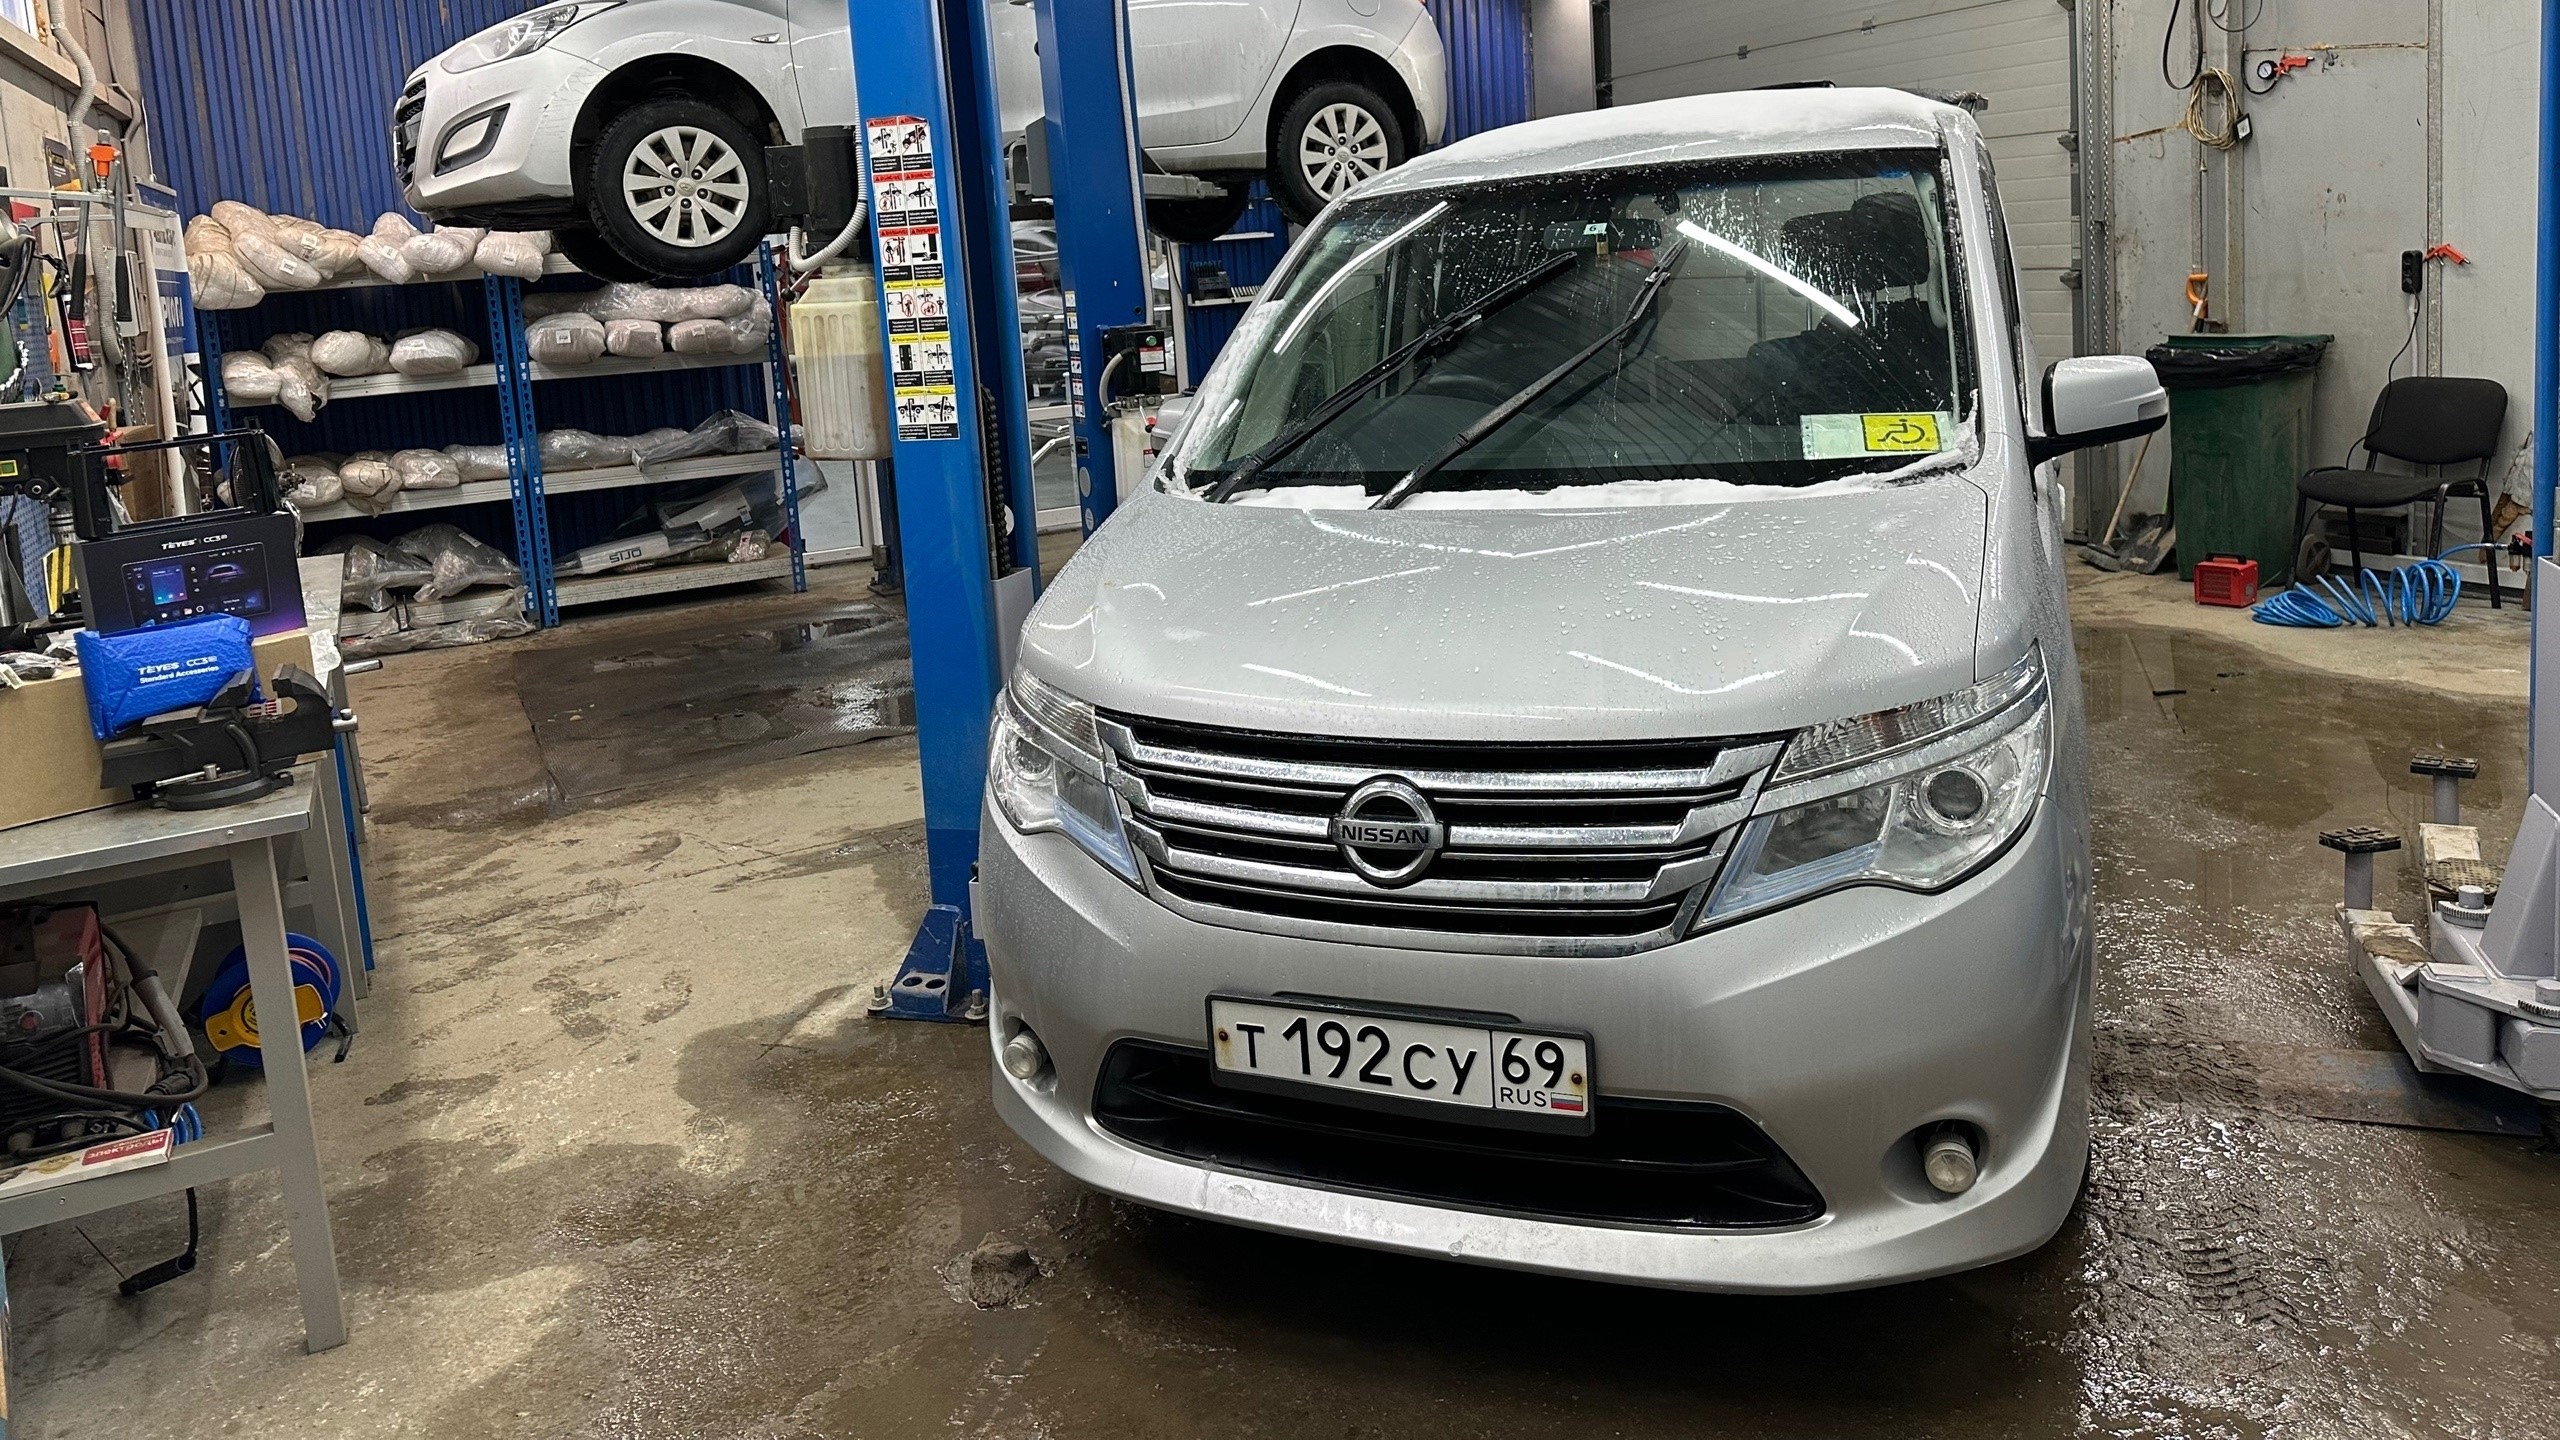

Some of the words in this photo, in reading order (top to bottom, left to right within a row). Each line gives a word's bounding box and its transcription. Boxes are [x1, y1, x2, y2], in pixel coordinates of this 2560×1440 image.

[161, 539, 195, 550] TEYES
[138, 662, 179, 675] TEYES
[140, 672, 175, 683] Standard
[176, 666, 219, 677] Accessories
[1341, 825, 1430, 845] NISSAN
[1501, 1038, 1565, 1089] 69
[1500, 1087, 1547, 1107] RUS
[87, 1136, 164, 1158] электроды
